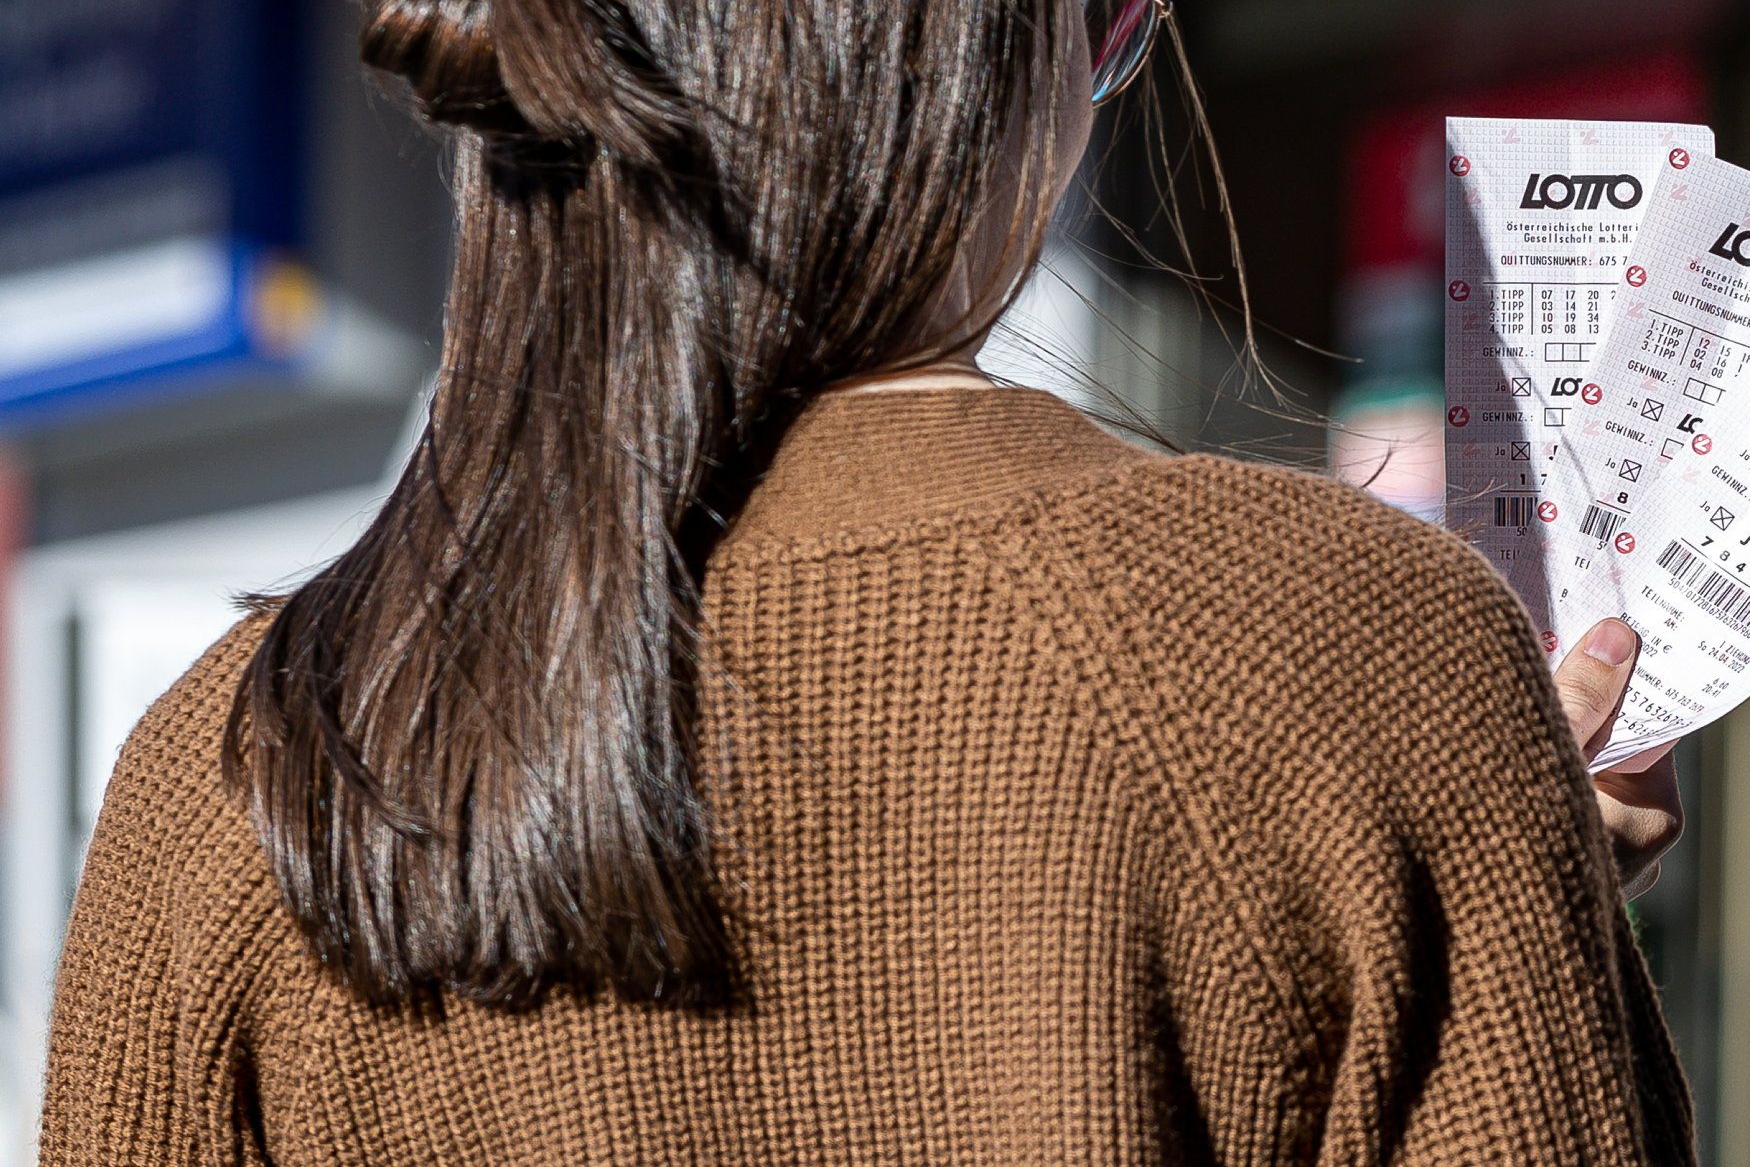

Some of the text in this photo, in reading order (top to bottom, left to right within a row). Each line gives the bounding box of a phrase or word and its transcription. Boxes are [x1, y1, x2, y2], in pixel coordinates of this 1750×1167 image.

[1519, 173, 1643, 210] LOTTO
[1506, 221, 1594, 232] Österreichische
[1524, 233, 1592, 244] Gesellschaft
[1500, 255, 1593, 266] QUITTUNGSNUMMER:
[1599, 255, 1617, 266] 675
[1490, 290, 1599, 300] 1.TIPP 07 17 20
[1489, 301, 1598, 311] 2.TIPP 03 14 21
[1489, 313, 1599, 323] 3.TIPP 10 19 34
[1489, 324, 1599, 334] 4.TIPP 05 08 13
[1650, 319, 1684, 338] 1.TIPP
[1699, 337, 1711, 350] 12
[1720, 345, 1731, 357] 15
[1482, 347, 1534, 357] GEWINNZ.:
[1645, 329, 1680, 349] 2.TIPP
[1694, 348, 1707, 360] 02
[1716, 357, 1727, 368] 16
[1641, 340, 1724, 379] 3.TIPP 04 08
[1627, 359, 1676, 386] GEWINNZ.:
[1626, 397, 1639, 409] Ja
[1482, 412, 1534, 422] GEWINNZ.:
[1605, 420, 1654, 447] GEWINNZ.:
[1617, 491, 1629, 504] 8
[1651, 635, 1662, 647] IN
[1662, 645, 1673, 654] €
[1708, 647, 1745, 674] 24.04.2022
